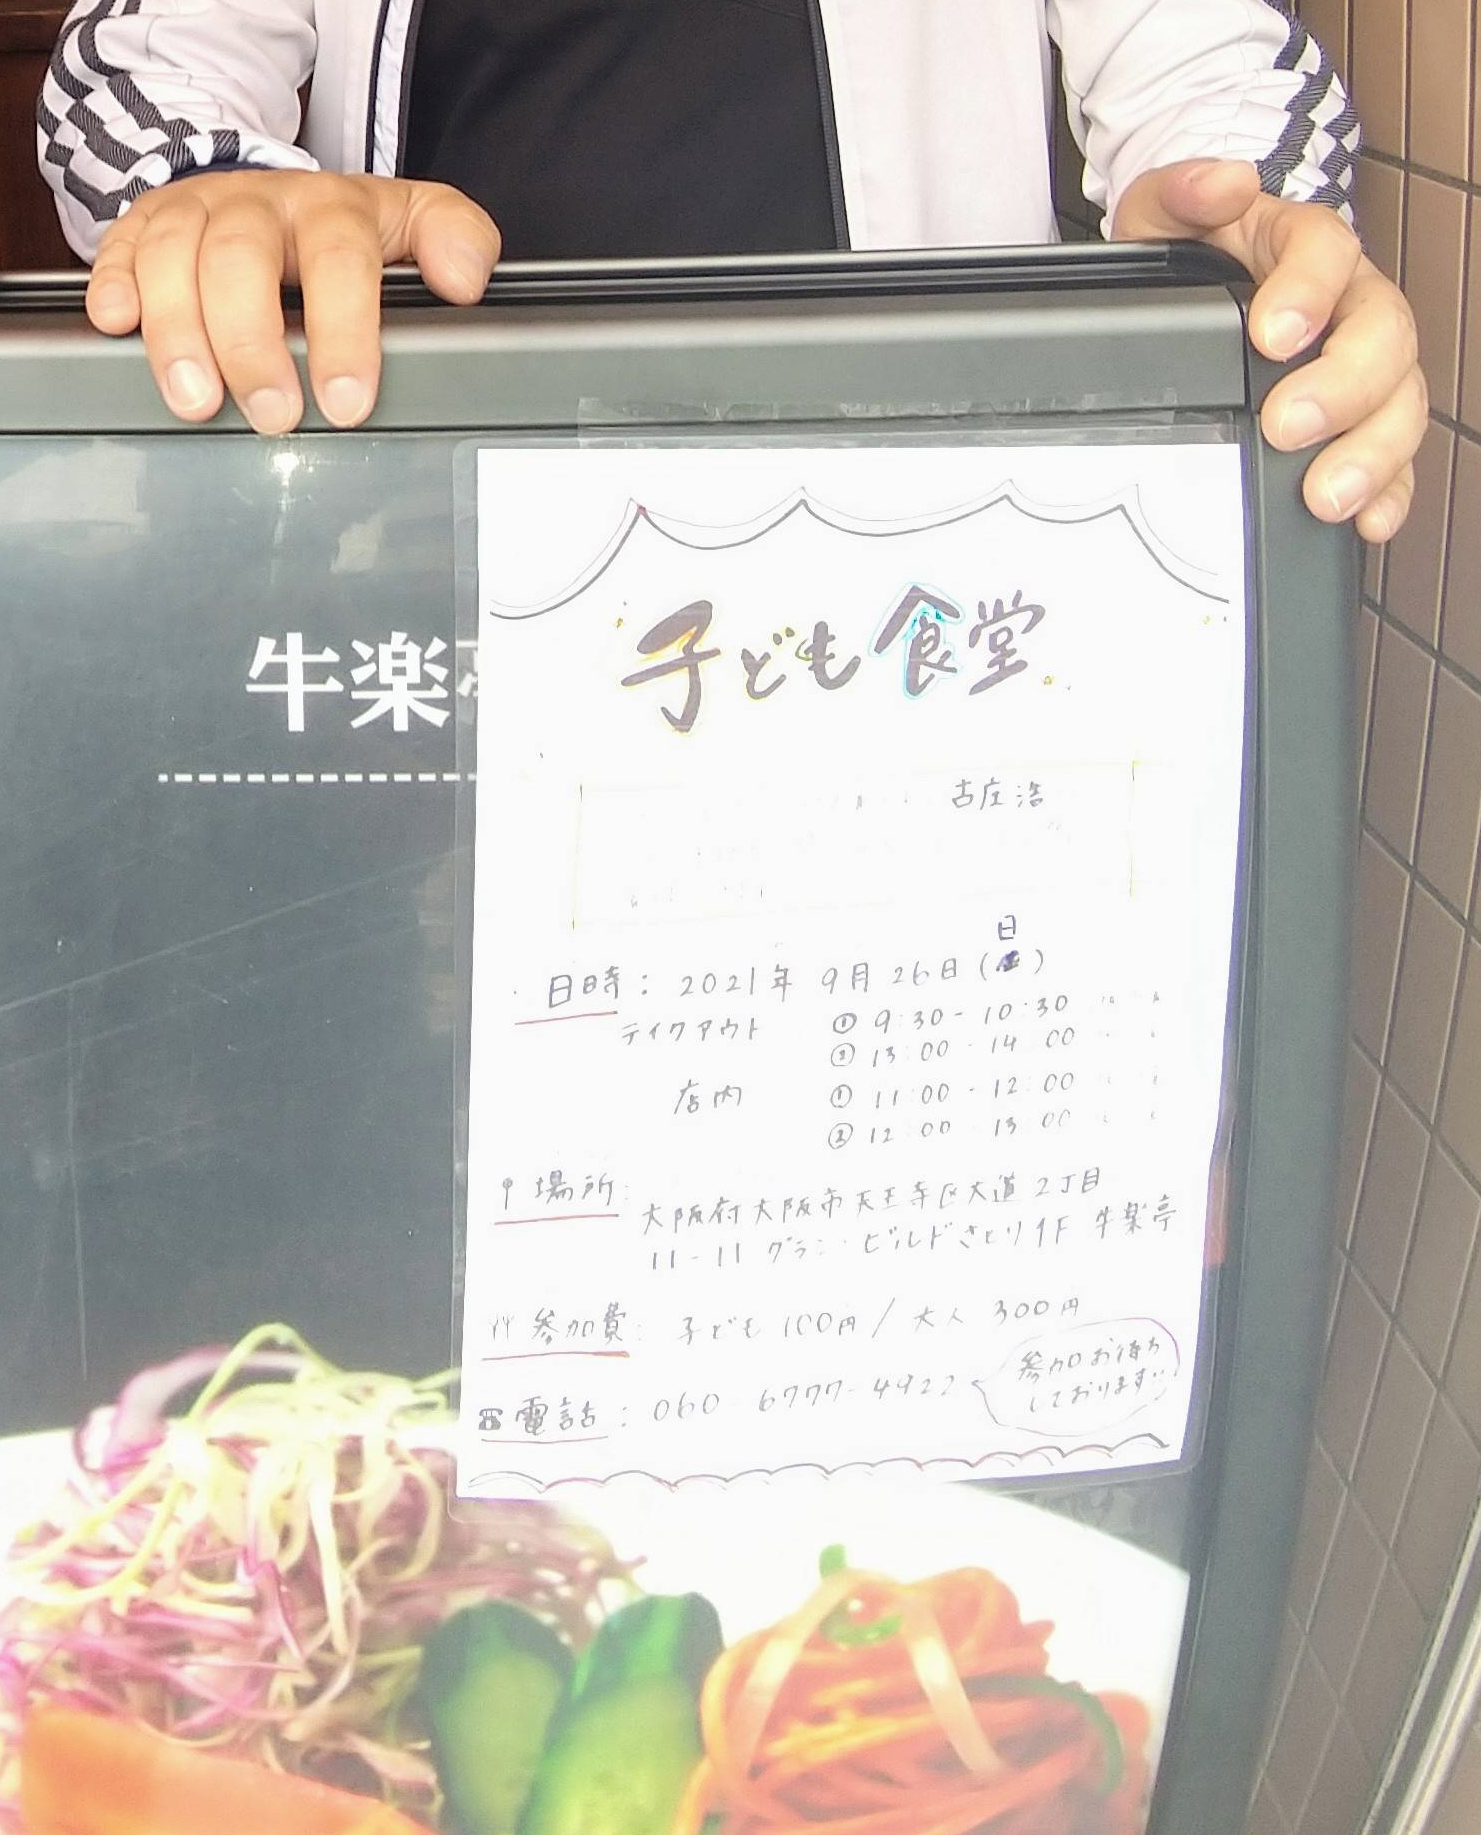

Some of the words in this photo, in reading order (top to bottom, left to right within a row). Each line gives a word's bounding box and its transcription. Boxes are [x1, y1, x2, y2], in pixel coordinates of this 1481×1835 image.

[245, 630, 477, 733] 牛楽
[619, 581, 1047, 735] 子ども食堂
